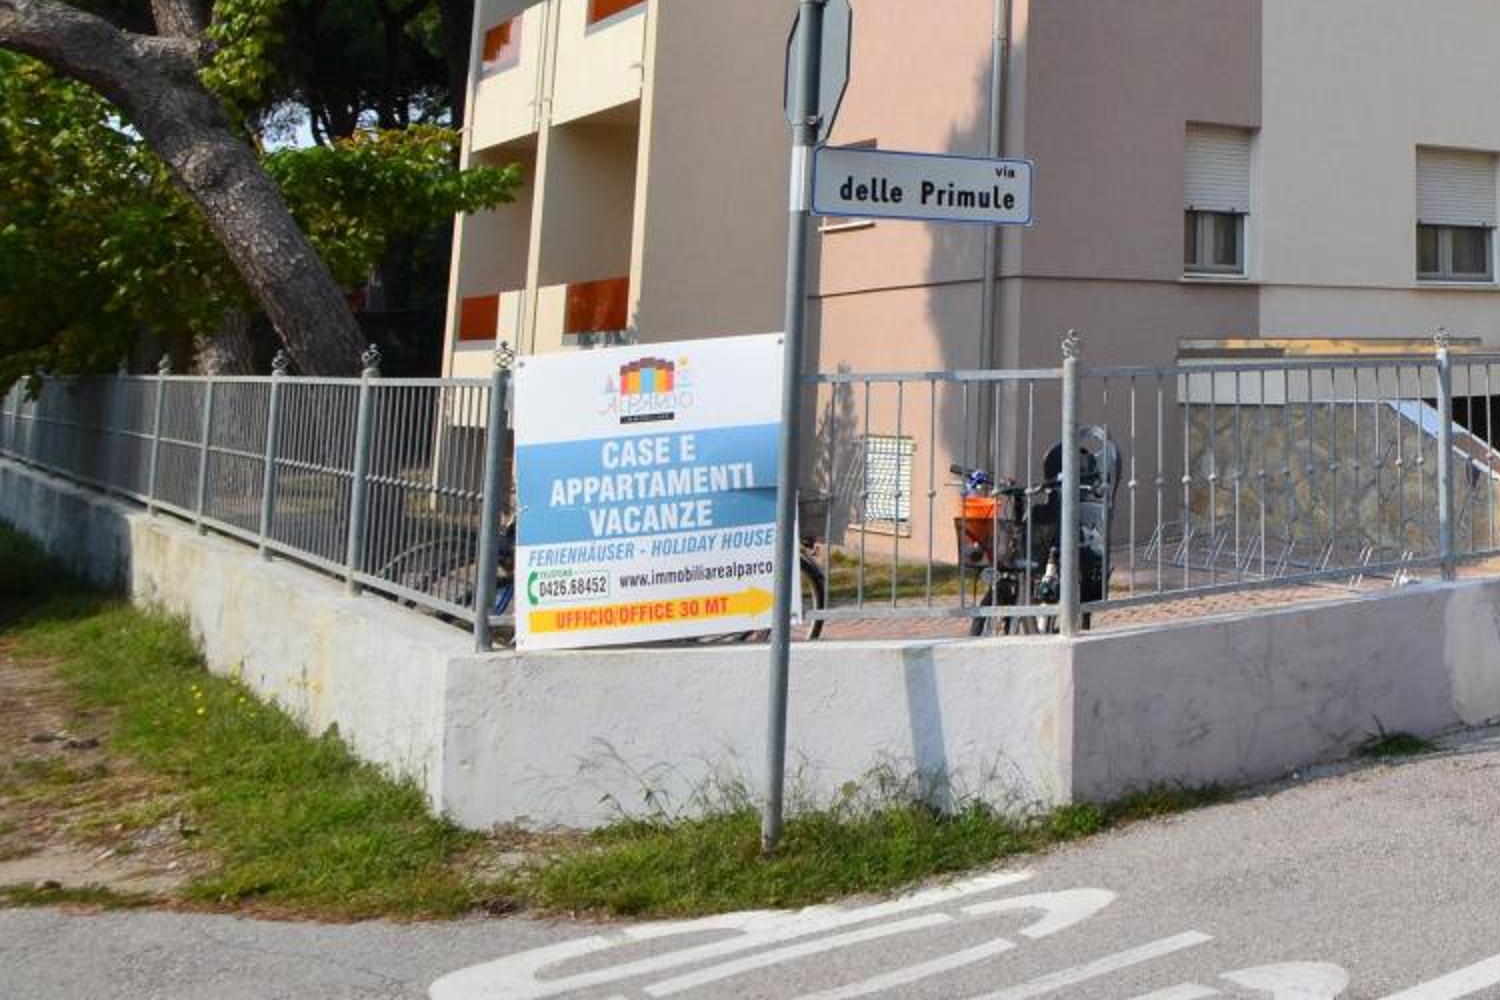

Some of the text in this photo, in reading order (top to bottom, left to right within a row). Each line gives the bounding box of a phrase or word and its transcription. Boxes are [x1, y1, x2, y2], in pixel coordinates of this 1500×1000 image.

[995, 164, 1015, 178] via
[839, 176, 1016, 209] delle Primule
[601, 433, 696, 469] CASE E
[550, 463, 754, 506] APPARTAMENTI
[589, 500, 713, 537] VACANZE
[651, 534, 717, 557] HOLIDAY
[722, 528, 774, 550] HOUSE
[539, 575, 607, 597] 0426.68452
[679, 600, 699, 617] 30
[705, 597, 729, 615] MT
